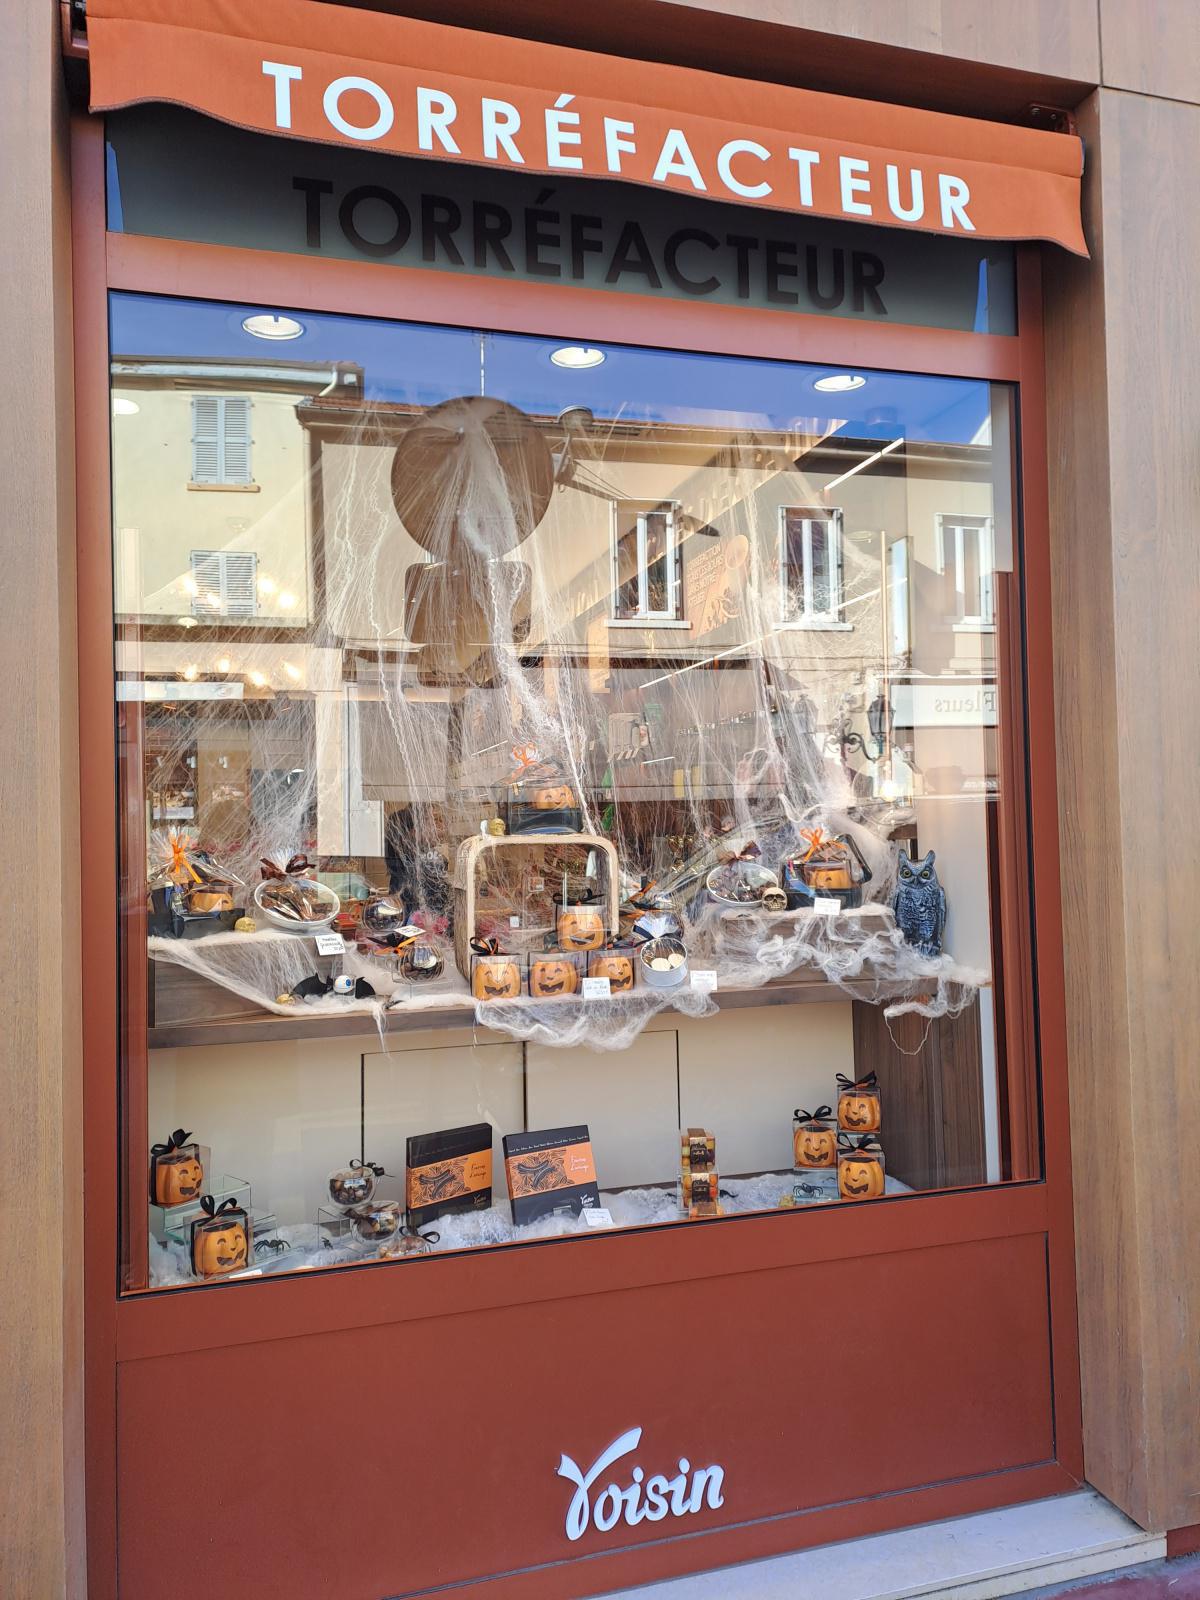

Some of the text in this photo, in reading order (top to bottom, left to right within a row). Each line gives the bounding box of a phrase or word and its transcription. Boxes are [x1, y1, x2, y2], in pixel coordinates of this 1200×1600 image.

[261, 60, 977, 232] TORRÉFACTEUR
[292, 176, 889, 316] TORRÉFACTEUR
[556, 1426, 725, 1541] Voisin
